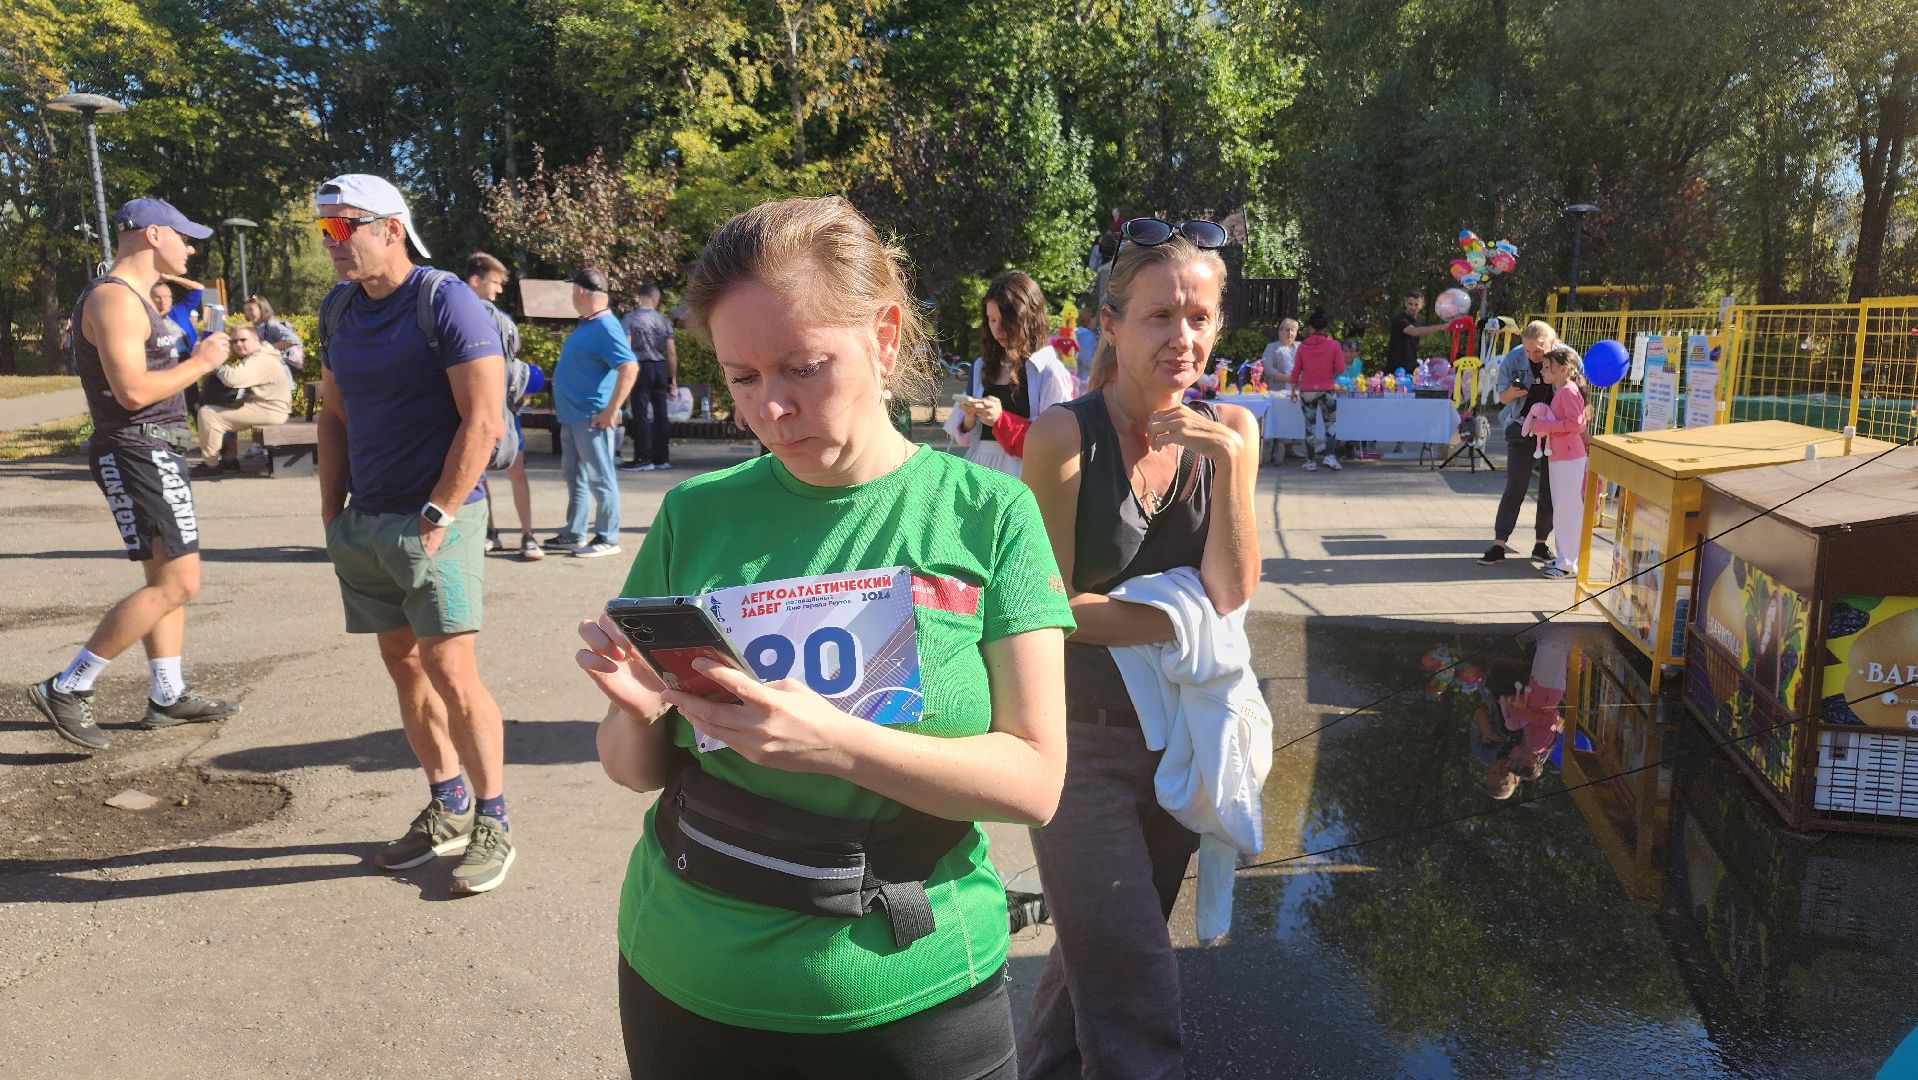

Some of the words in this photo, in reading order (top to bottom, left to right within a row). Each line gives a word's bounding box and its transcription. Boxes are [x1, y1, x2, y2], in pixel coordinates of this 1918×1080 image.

[99, 453, 140, 550] LEGENDA
[152, 450, 198, 544] LEGENDA
[741, 575, 892, 605] ЛЕГКОАТЛЕТИЧЕСКИЙ
[741, 602, 781, 618] ЗАБЕГ
[802, 602, 827, 610] города
